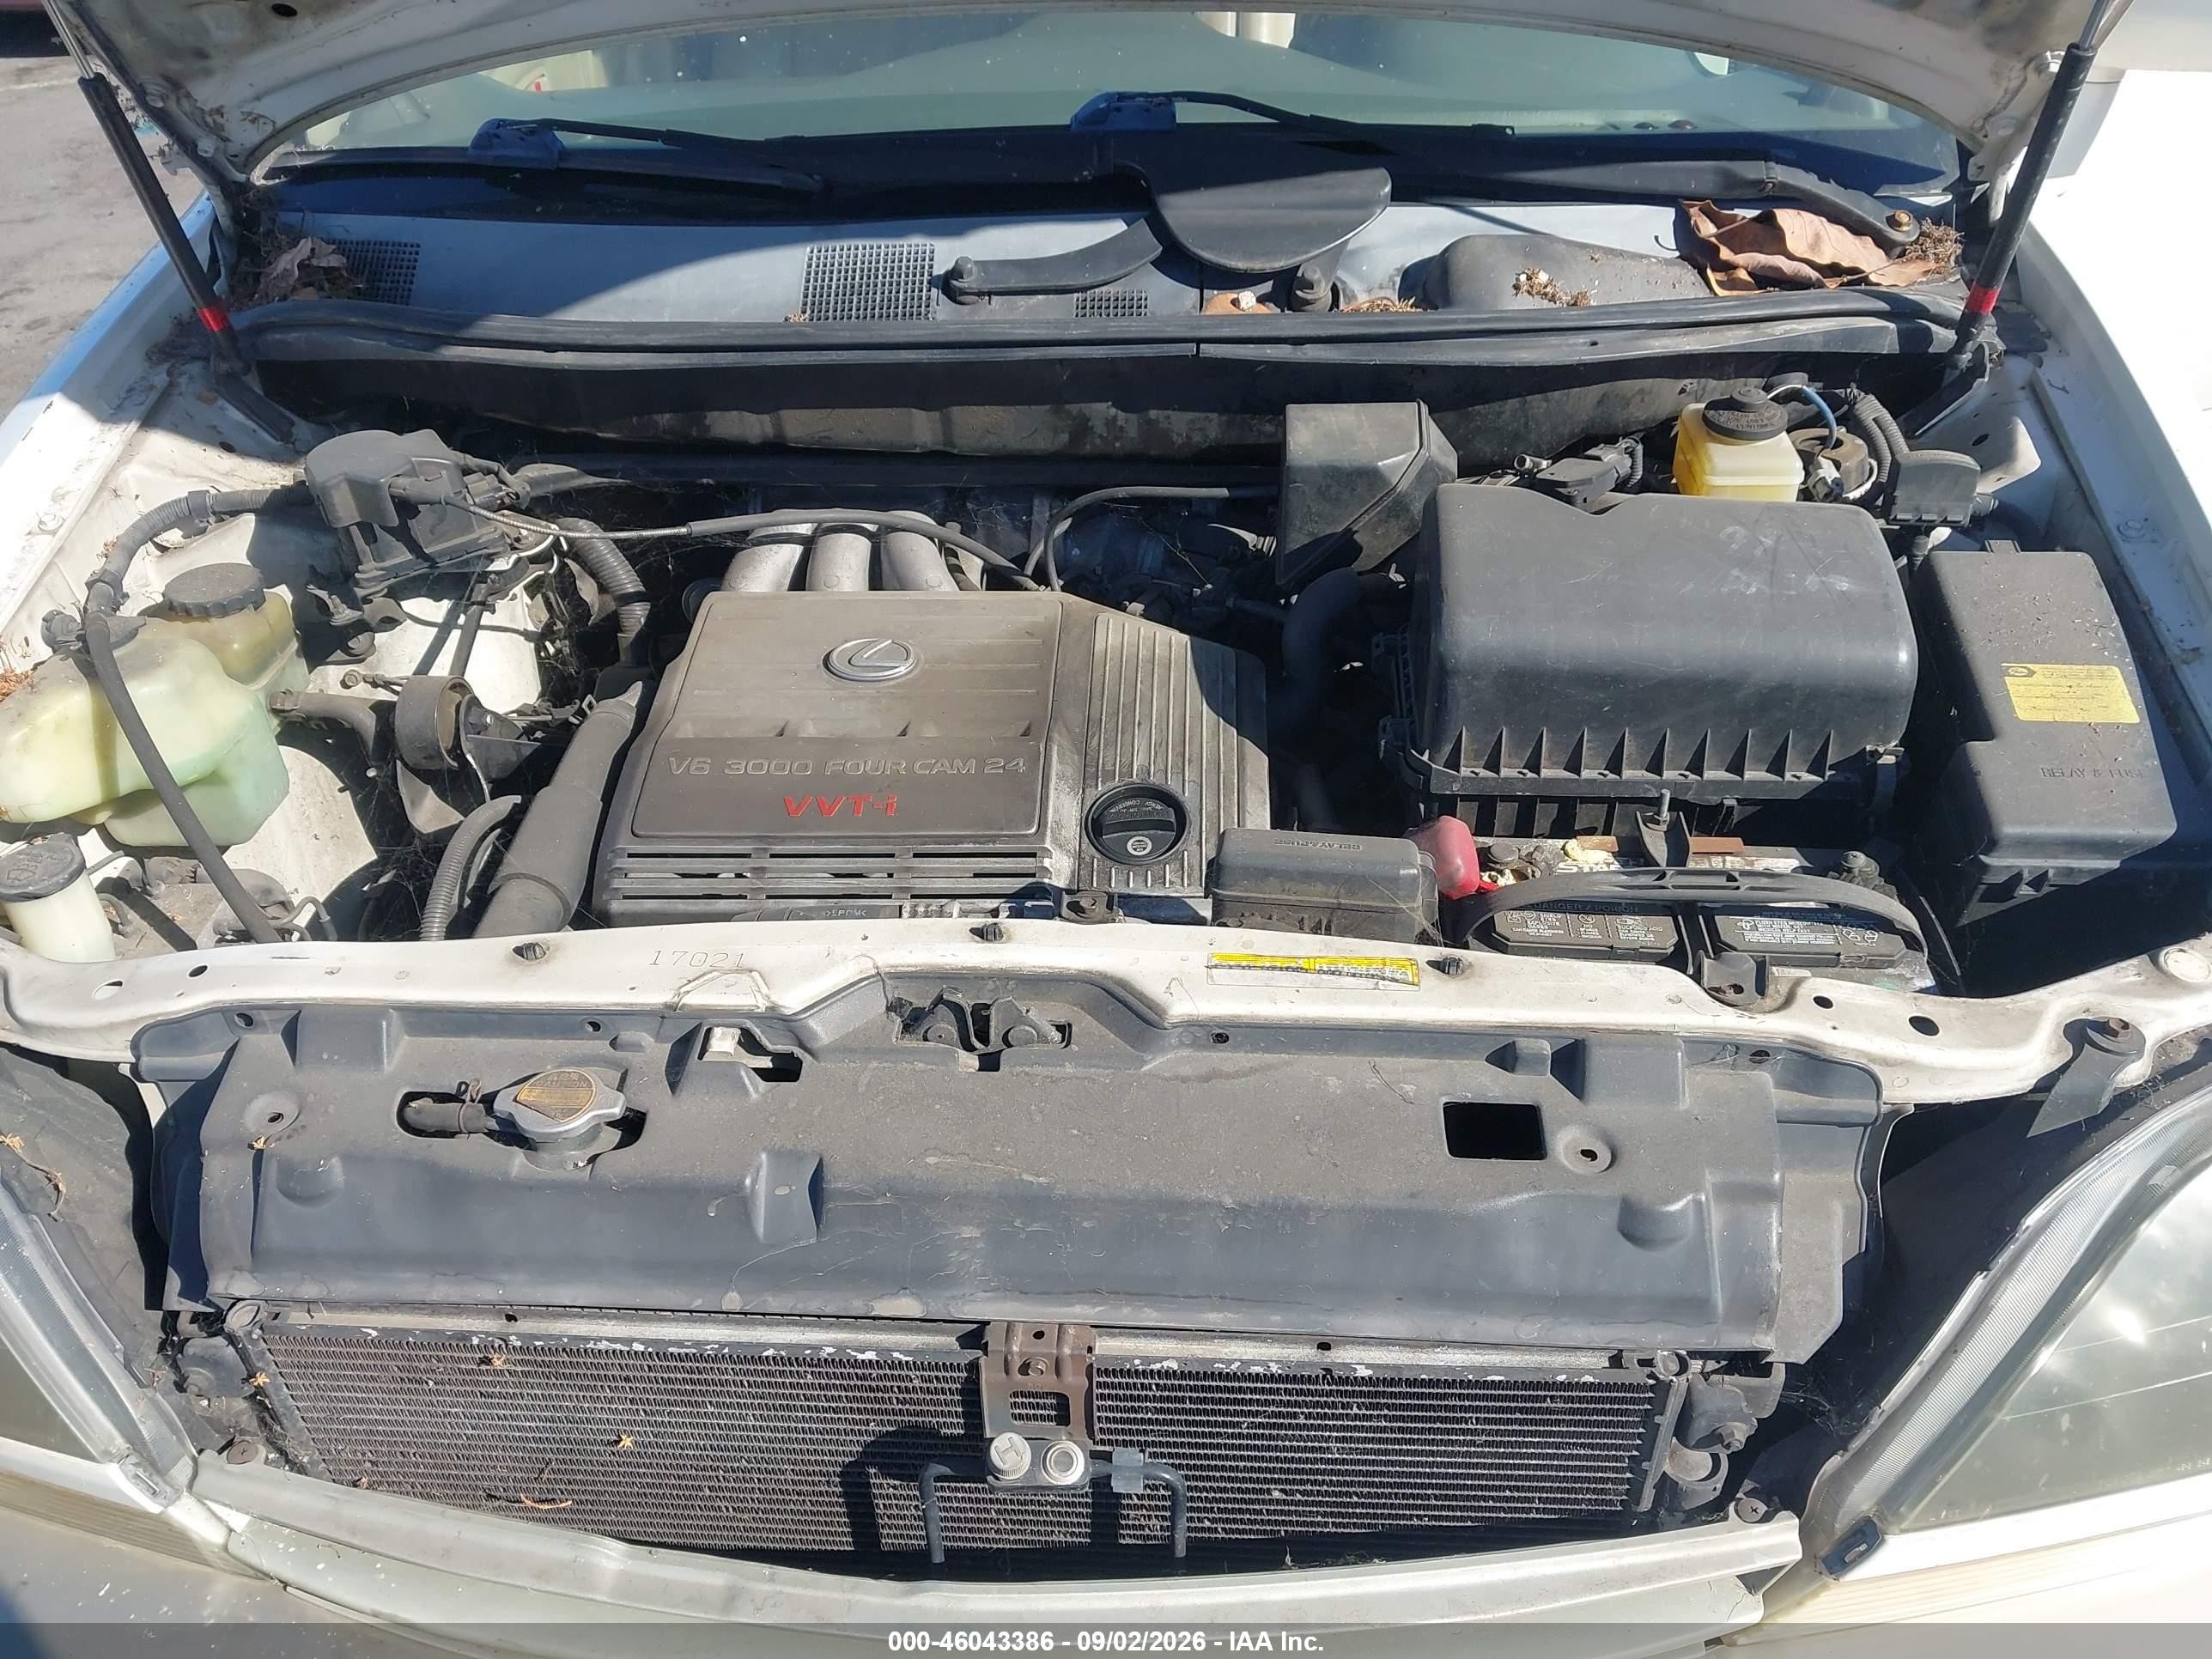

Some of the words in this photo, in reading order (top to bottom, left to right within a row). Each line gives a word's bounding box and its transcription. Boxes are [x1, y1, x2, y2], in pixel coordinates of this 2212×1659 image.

[669, 757, 712, 775] V6
[724, 758, 813, 776] 3000
[824, 758, 907, 775] FOUR
[913, 758, 975, 775] CAM
[983, 757, 1026, 774] 24
[783, 796, 899, 817] VVT-i
[1534, 902, 1583, 911] DANGER
[1594, 903, 1638, 913] POISON
[649, 949, 744, 969] 17021
[535, 1079, 587, 1088] CAUON
